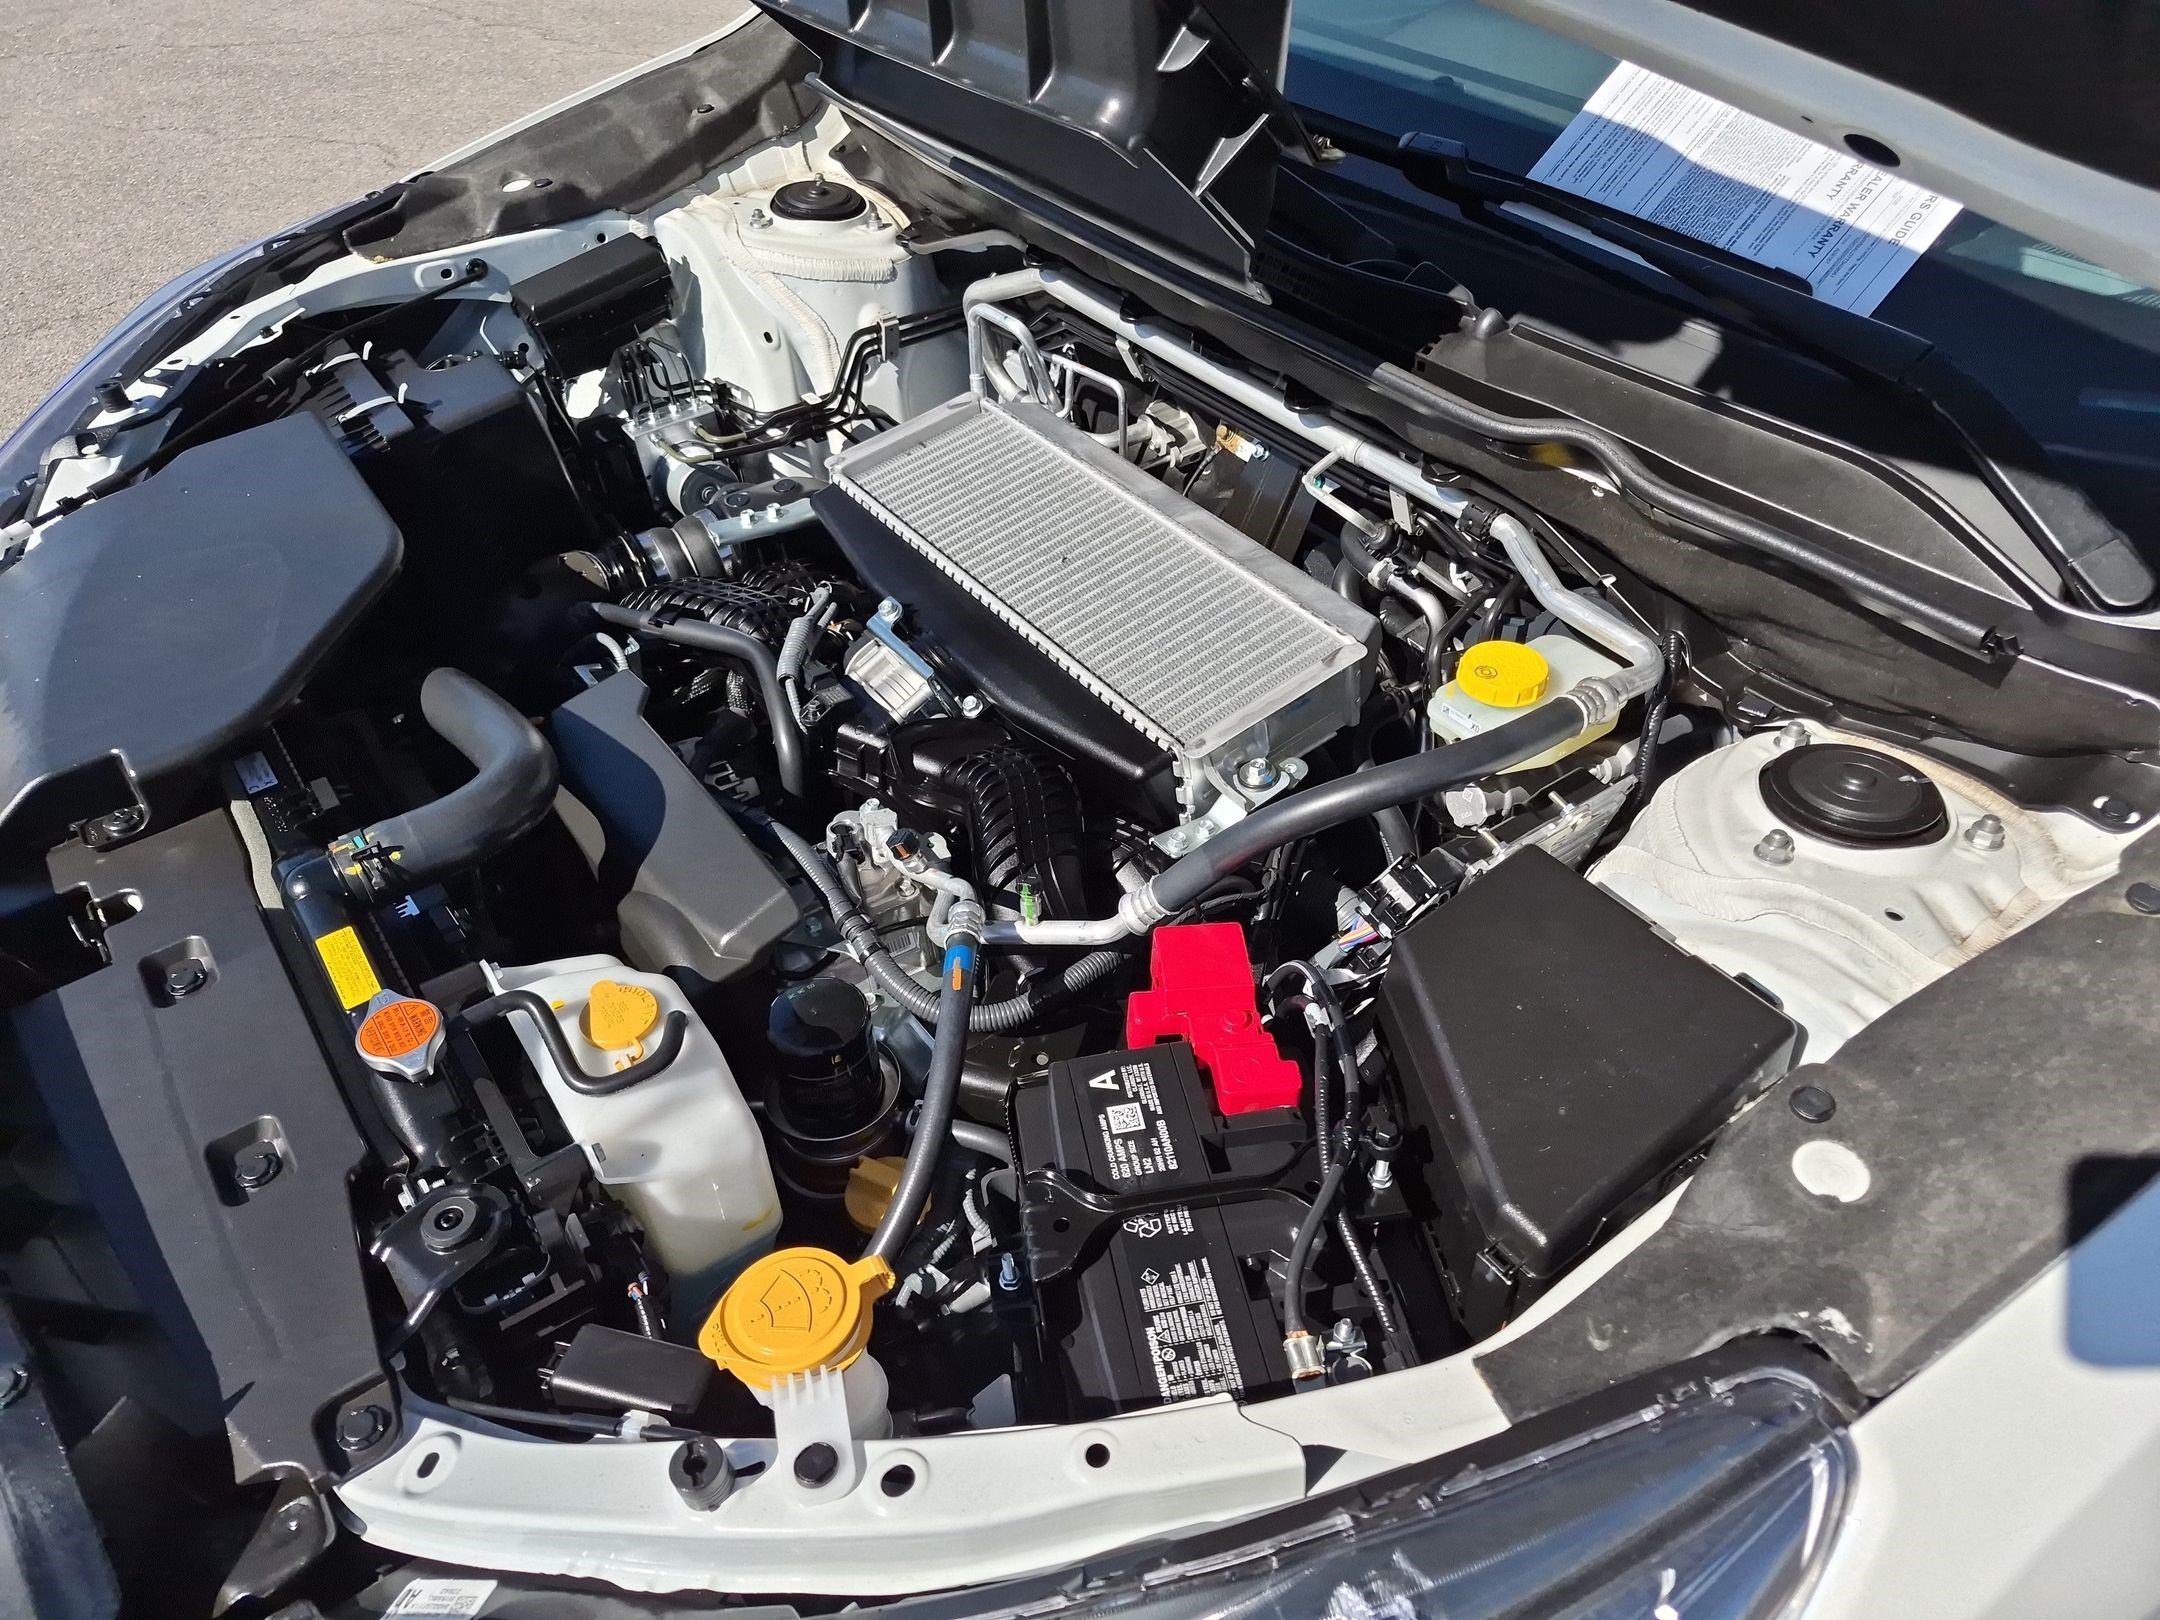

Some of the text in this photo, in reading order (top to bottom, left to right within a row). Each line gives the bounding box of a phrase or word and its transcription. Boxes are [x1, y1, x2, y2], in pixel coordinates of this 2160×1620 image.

[1806, 200, 1859, 258] WARRANTY
[1887, 210, 1922, 249] GUIDE
[1088, 1069, 1120, 1091] A
[1097, 1113, 1120, 1179] COLD CRANKING AMPS
[1113, 1138, 1131, 1178] 620 AMPS
[1127, 1139, 1142, 1175] GROUP SIZE
[1150, 1137, 1159, 1146] AH
[1153, 1146, 1161, 1155] 62
[1142, 1156, 1154, 1173] LN2
[1144, 1326, 1172, 1404] DANGER/POISON
